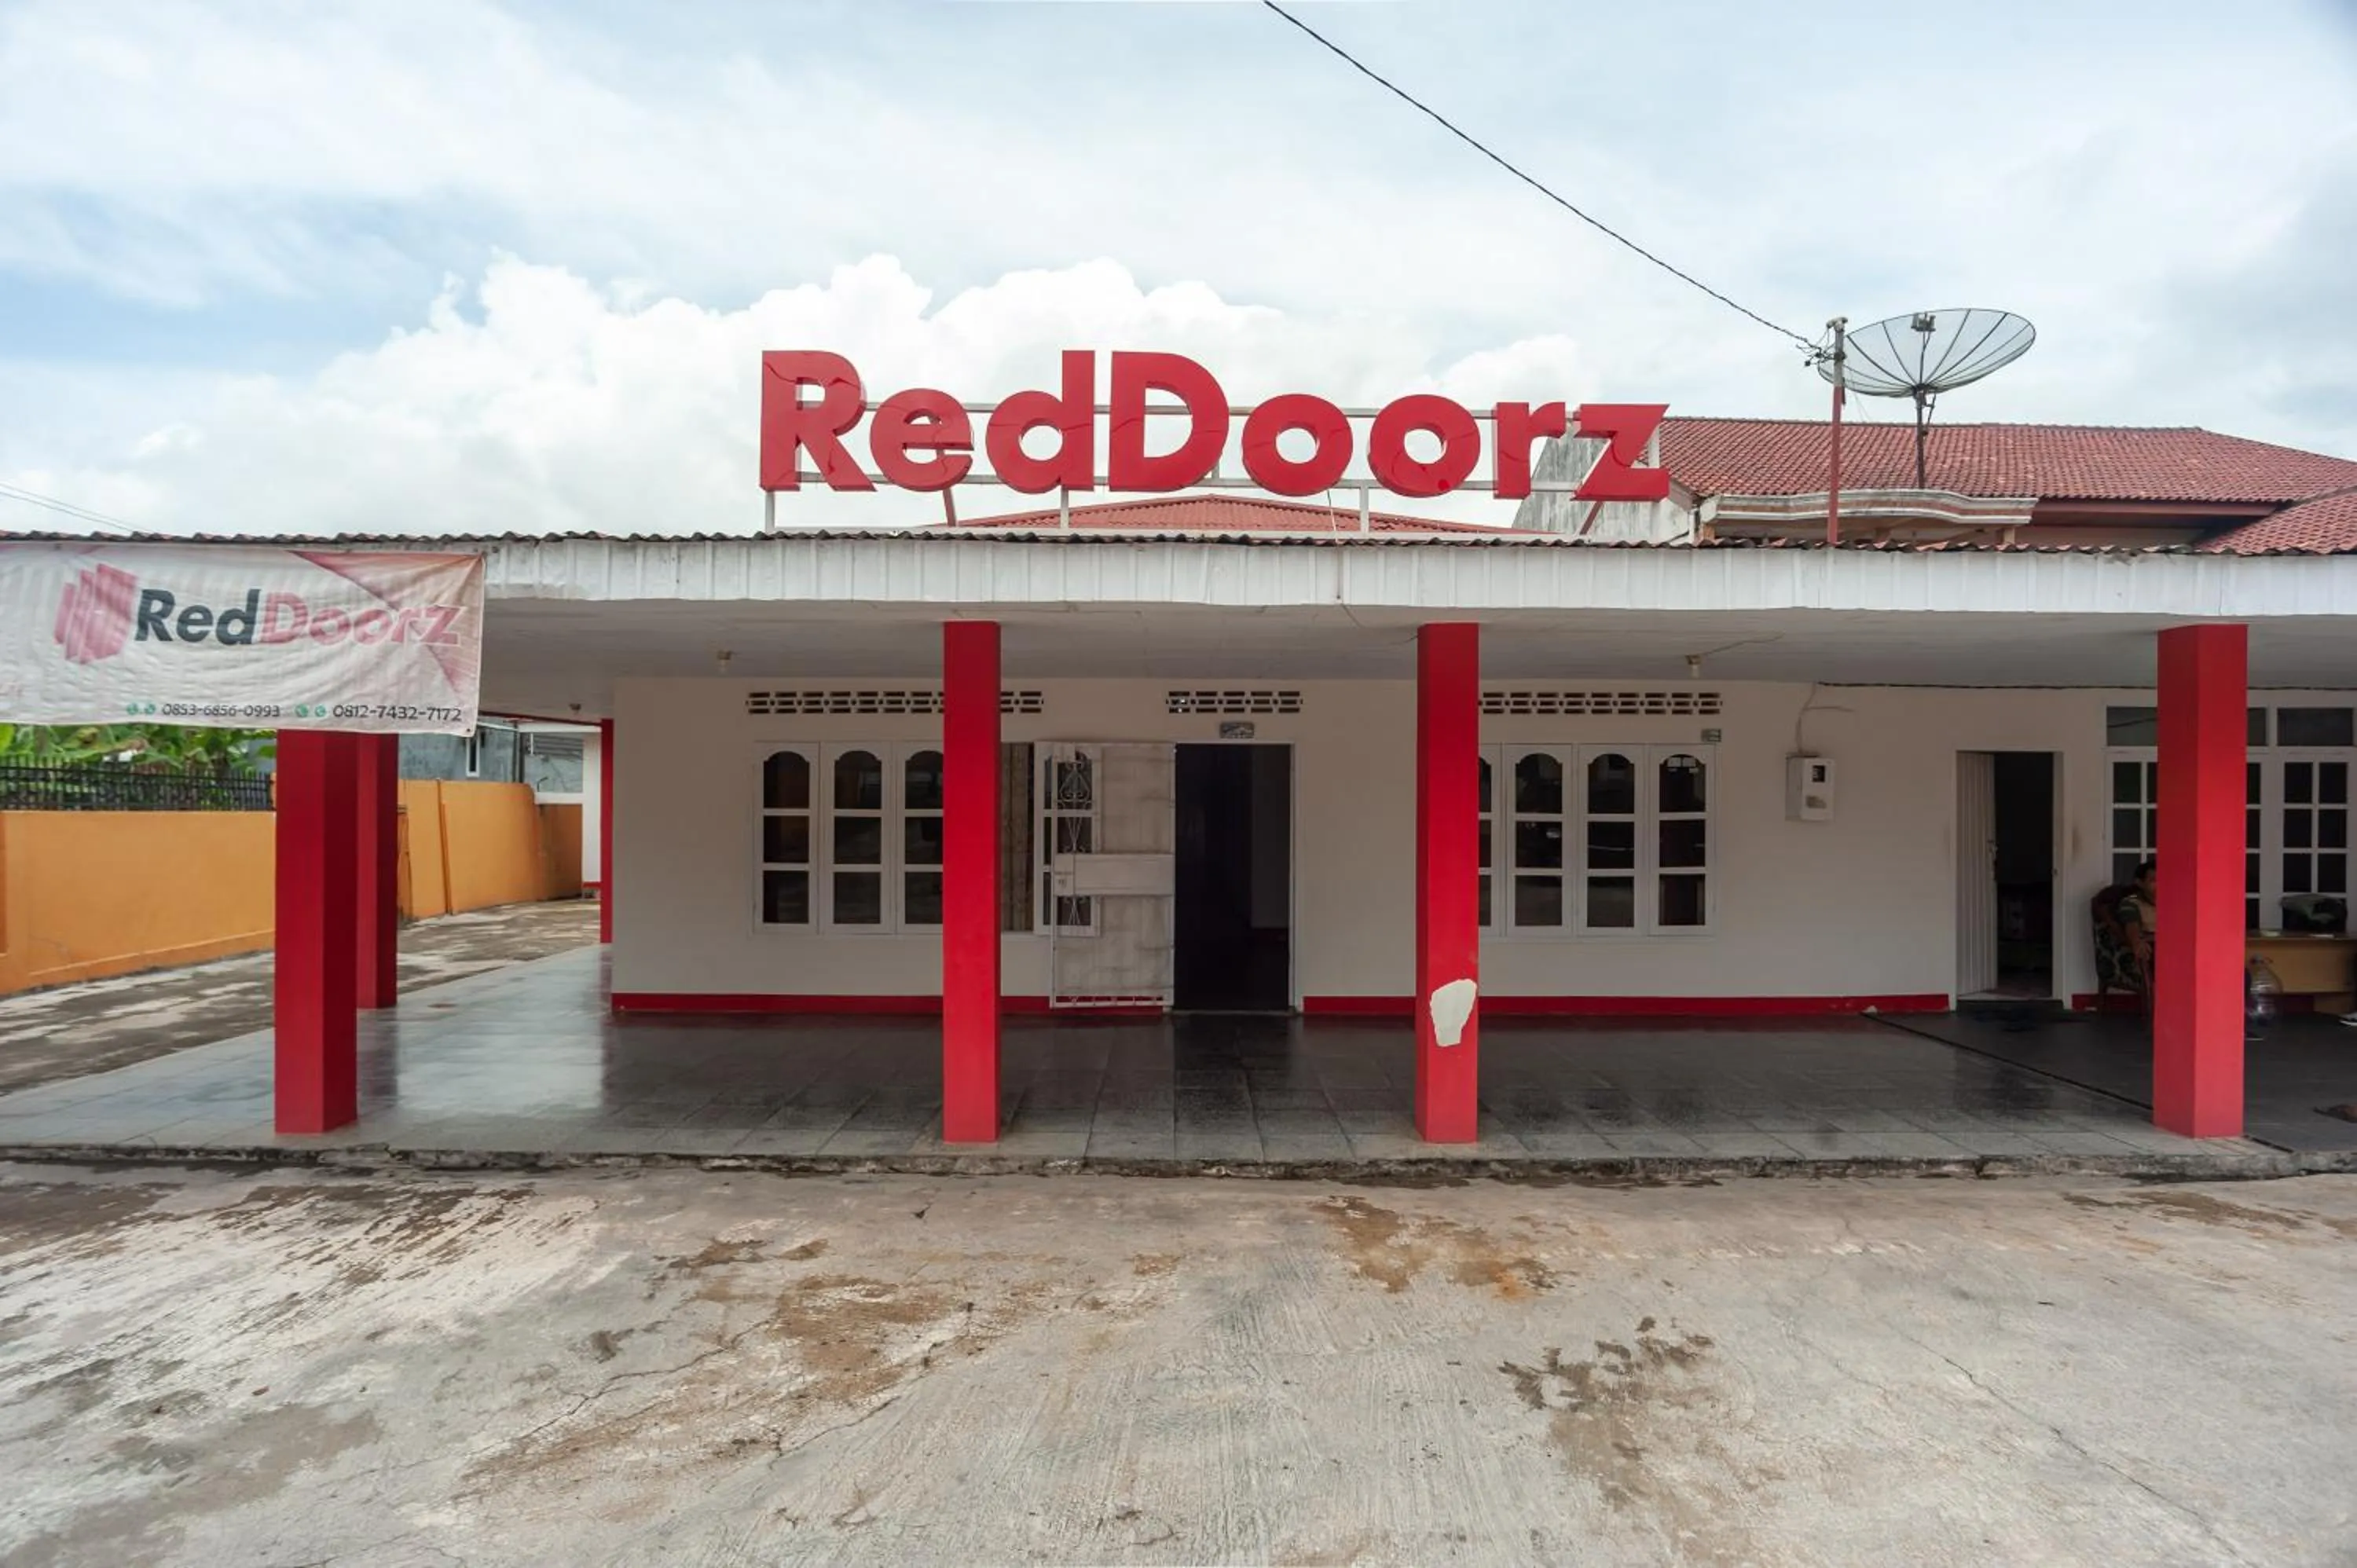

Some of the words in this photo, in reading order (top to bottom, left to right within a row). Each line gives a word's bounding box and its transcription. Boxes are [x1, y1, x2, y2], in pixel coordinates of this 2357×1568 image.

[761, 350, 1670, 501] RedDoorz
[134, 588, 466, 645] RedDoorz
[162, 703, 280, 718] 0853-6856-0993
[333, 705, 462, 722] 0812-7432-7172
